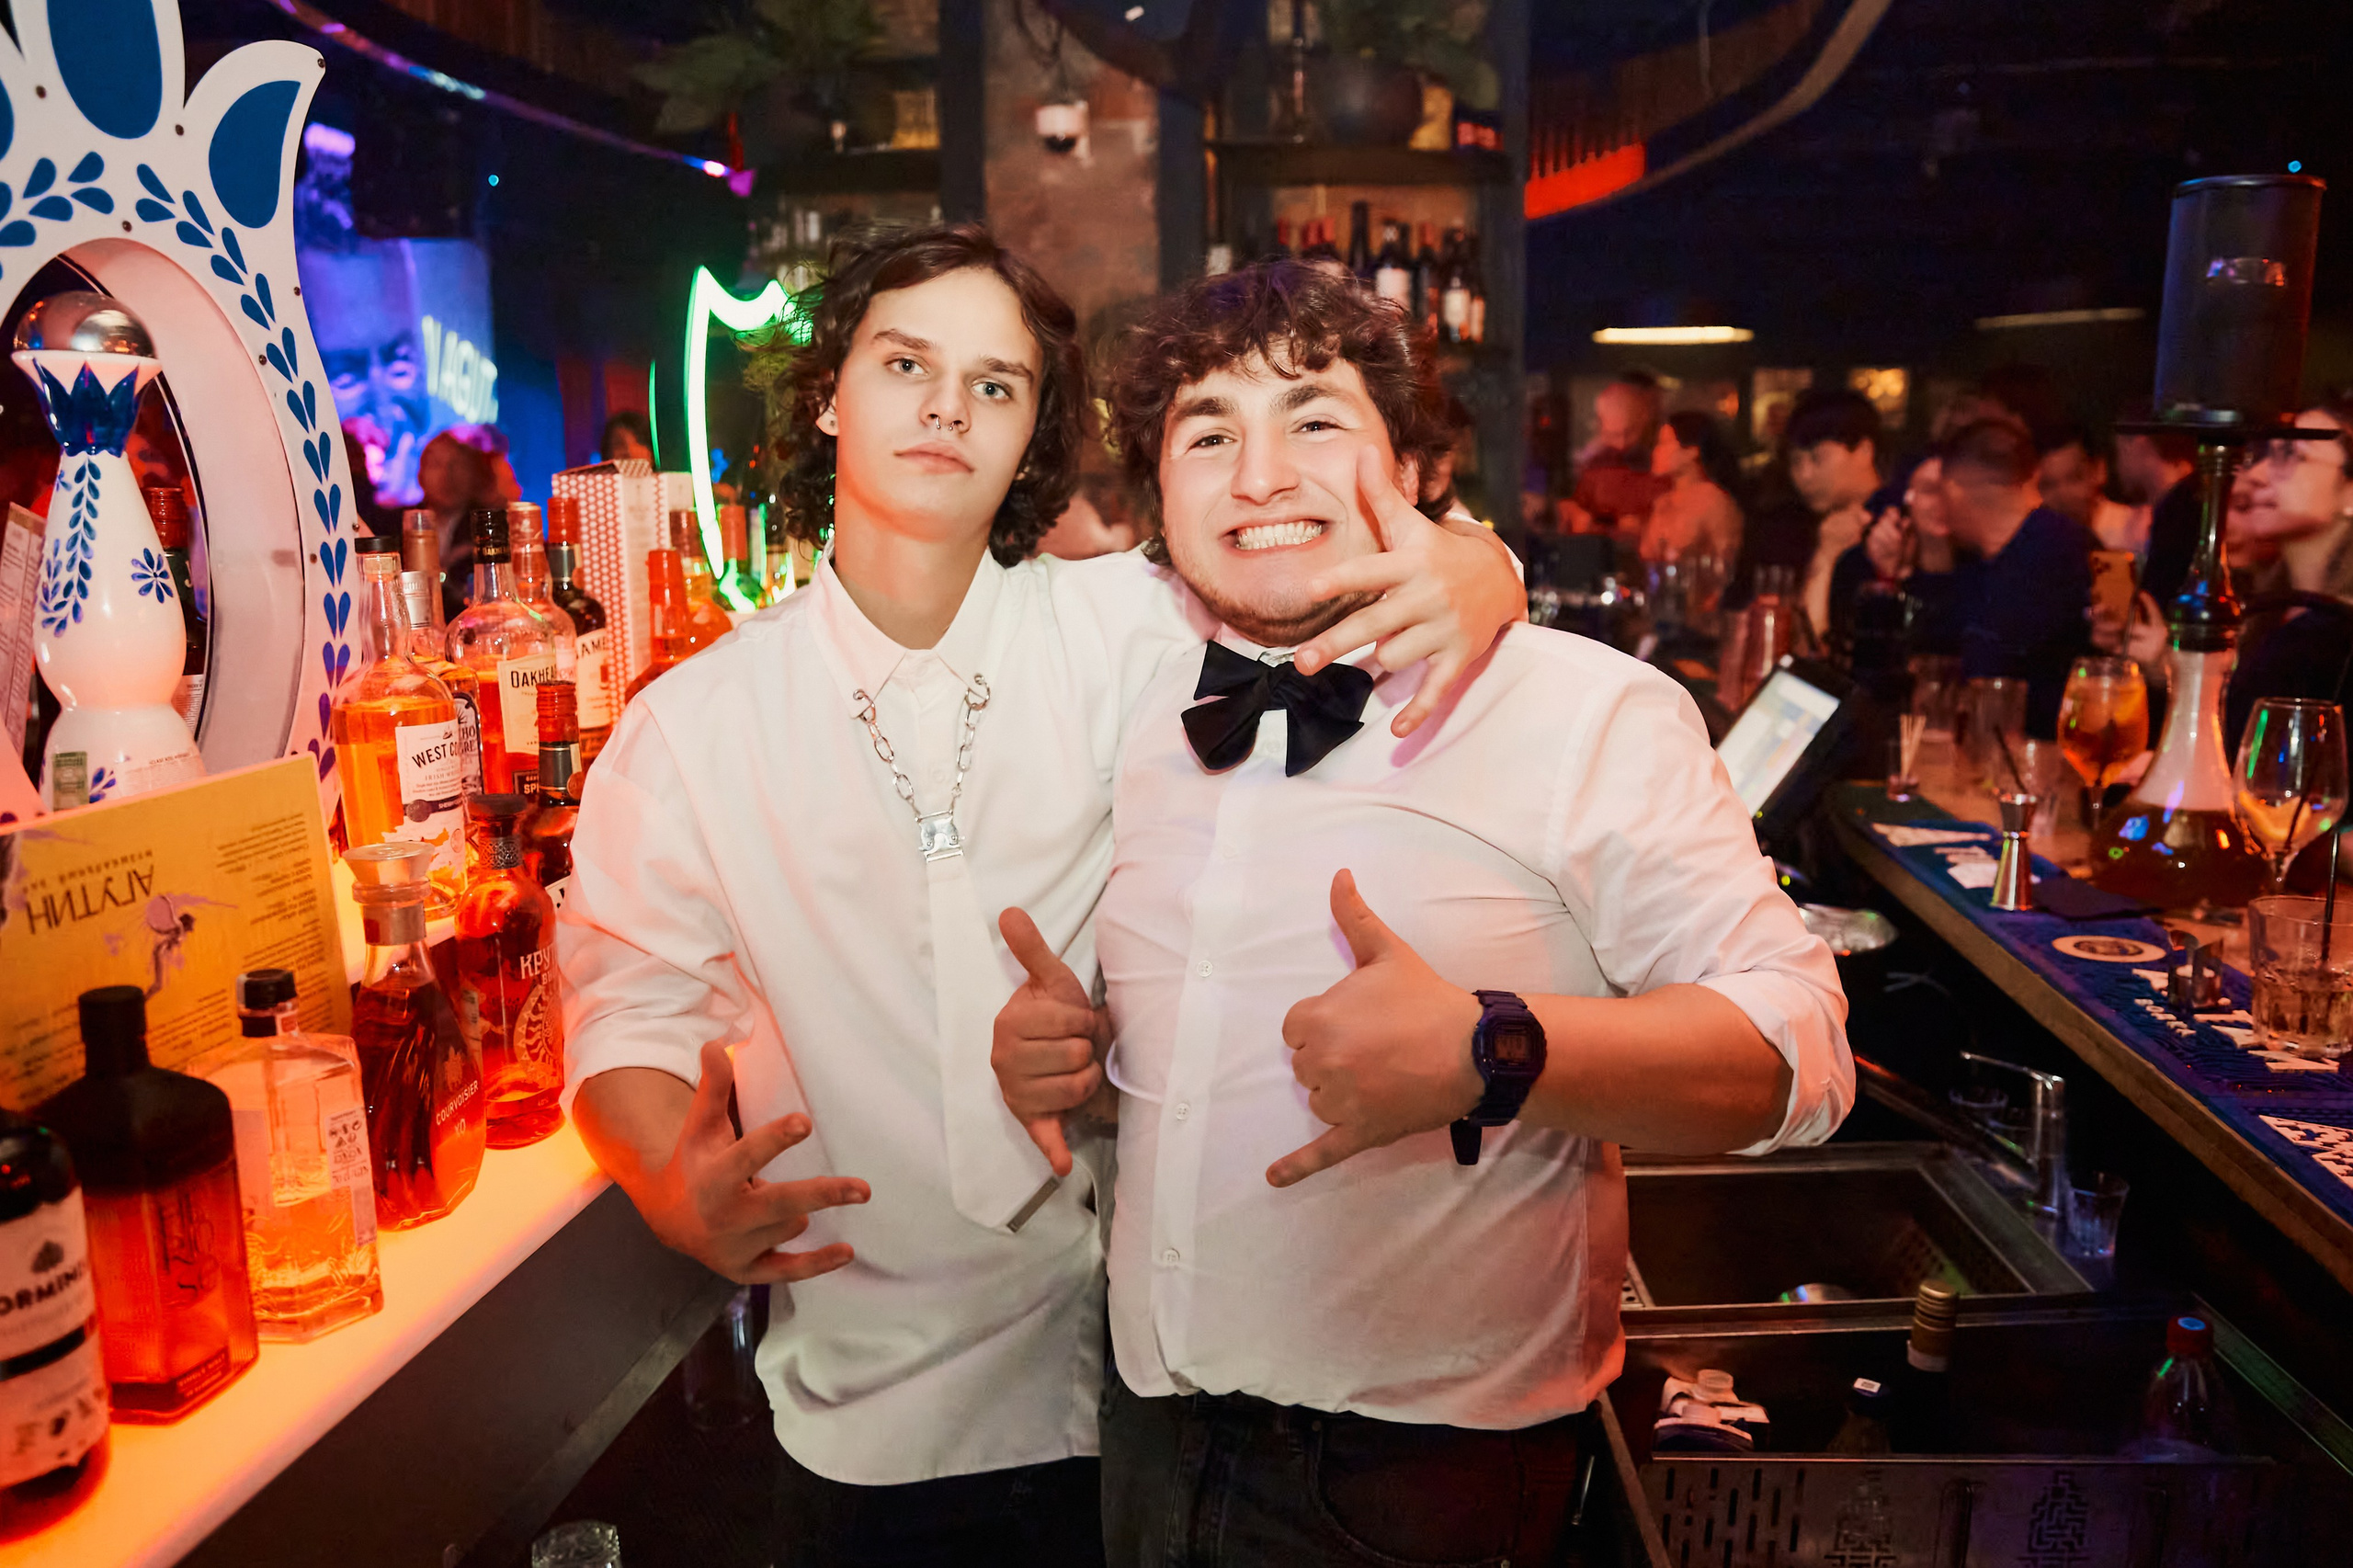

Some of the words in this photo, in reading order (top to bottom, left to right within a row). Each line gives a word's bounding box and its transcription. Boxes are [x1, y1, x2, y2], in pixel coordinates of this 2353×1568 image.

[412, 744, 447, 768] WEST
[26, 864, 155, 936] АГУТИН
[436, 1080, 479, 1126] COURVOISIER
[454, 1118, 466, 1138] XO
